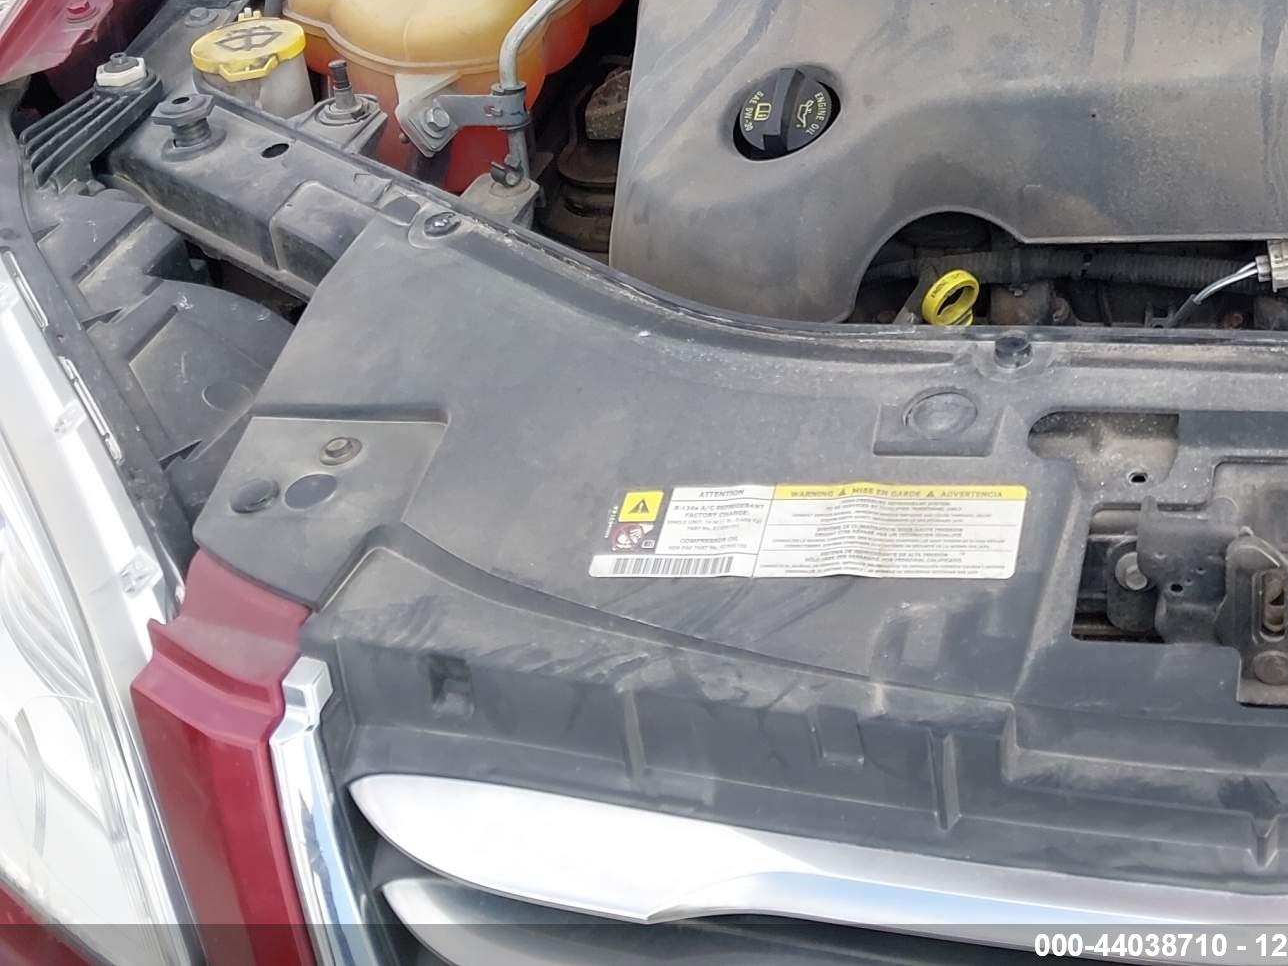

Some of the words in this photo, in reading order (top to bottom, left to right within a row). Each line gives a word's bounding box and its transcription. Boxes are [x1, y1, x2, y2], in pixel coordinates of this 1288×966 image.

[748, 90, 765, 105] SAE
[814, 92, 827, 121] ENGINE
[805, 122, 820, 136] OIL
[699, 489, 745, 498] ATTENTION
[791, 490, 834, 498] WARNING
[891, 490, 921, 498] GARDE
[940, 490, 1003, 498] ADVERTENCIA
[701, 503, 715, 511] A/C
